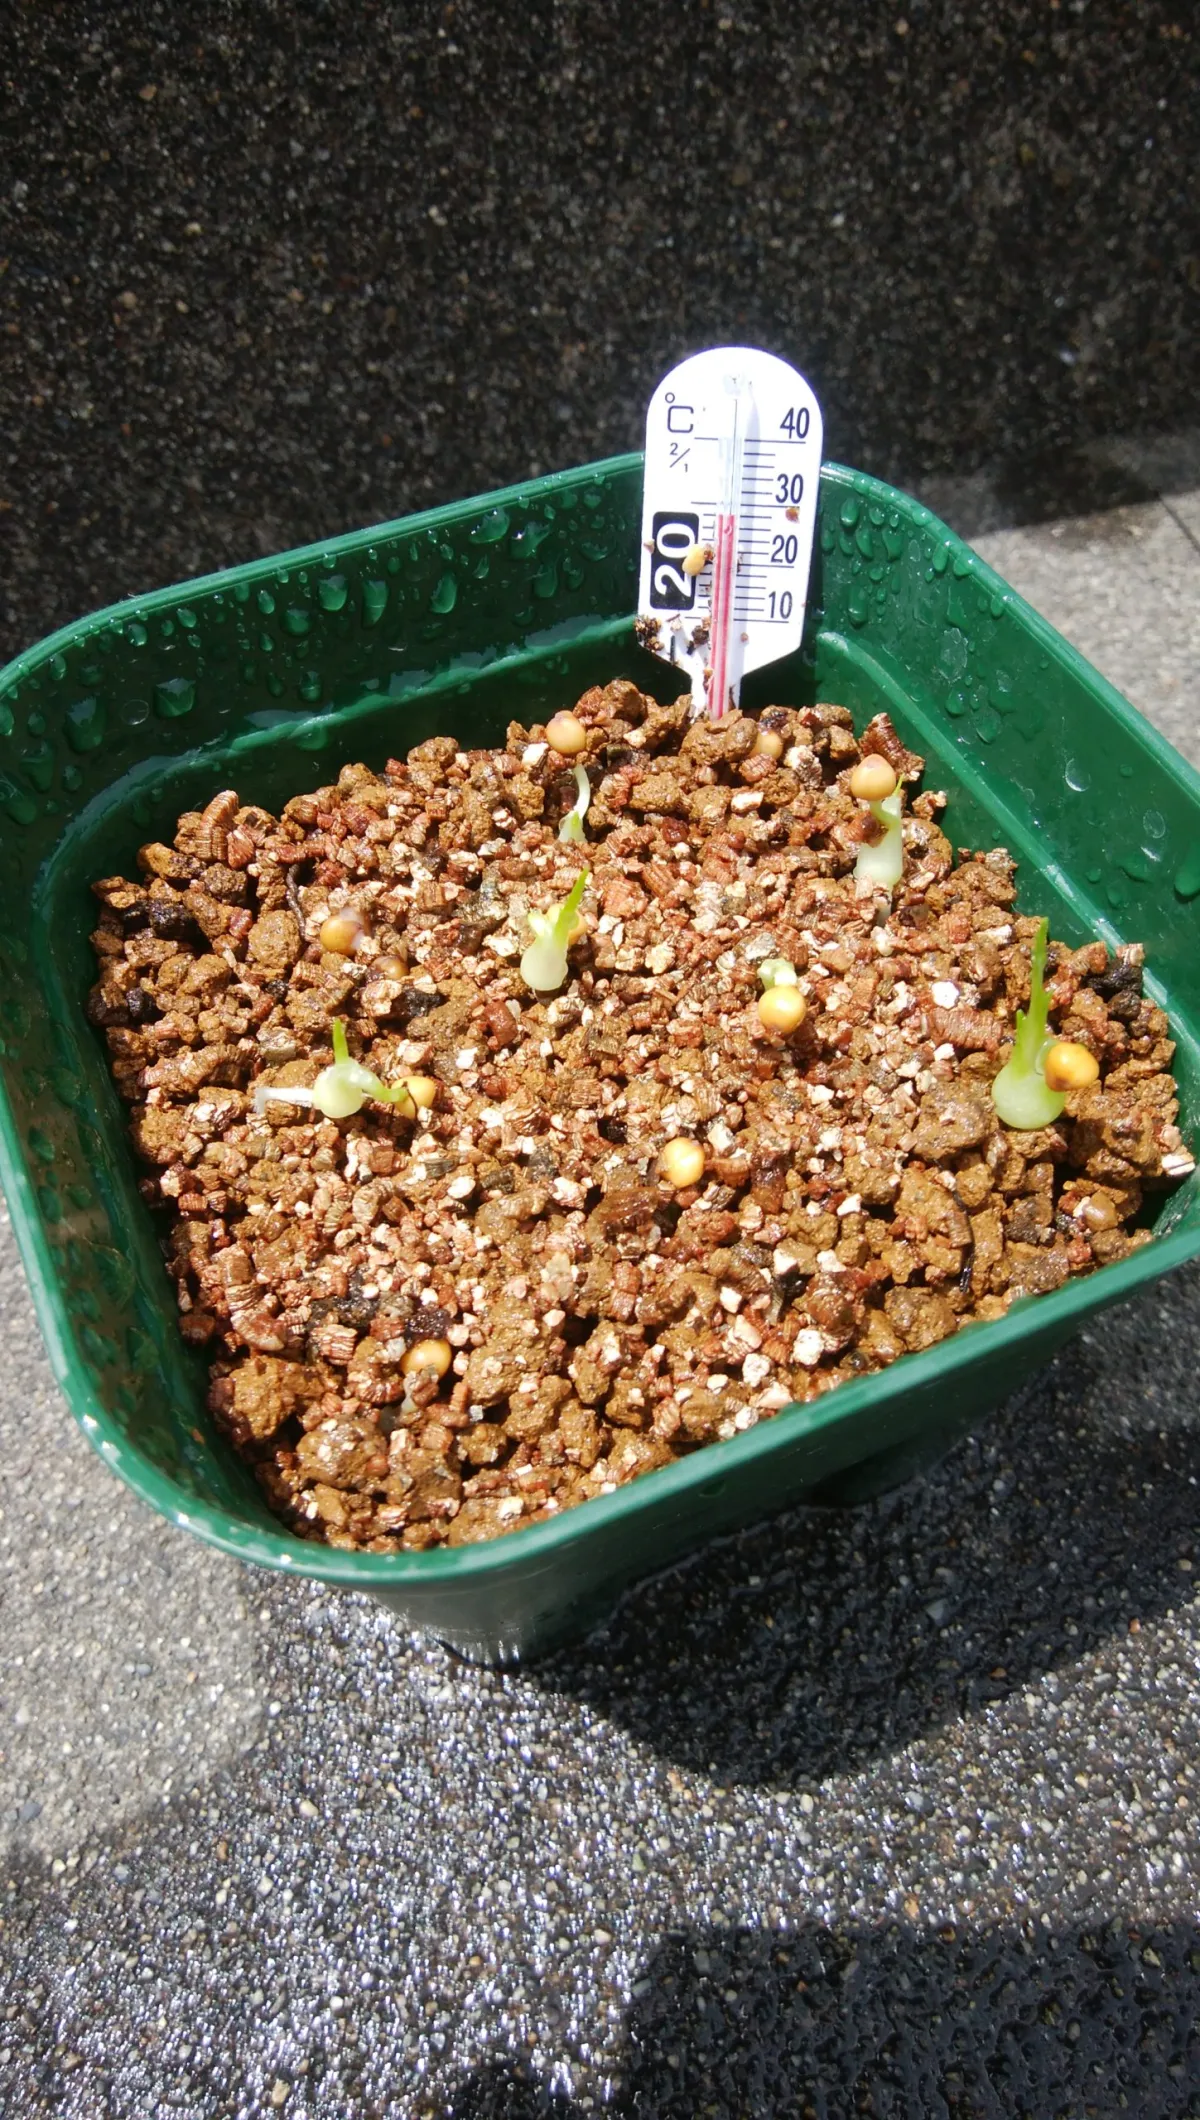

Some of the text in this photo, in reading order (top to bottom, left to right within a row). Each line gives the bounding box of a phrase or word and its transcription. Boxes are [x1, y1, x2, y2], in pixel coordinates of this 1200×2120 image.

[780, 407, 810, 439] 40
[775, 473, 803, 504] 30
[654, 522, 695, 597] 20
[770, 534, 798, 564] 20
[768, 590, 793, 619] 10
